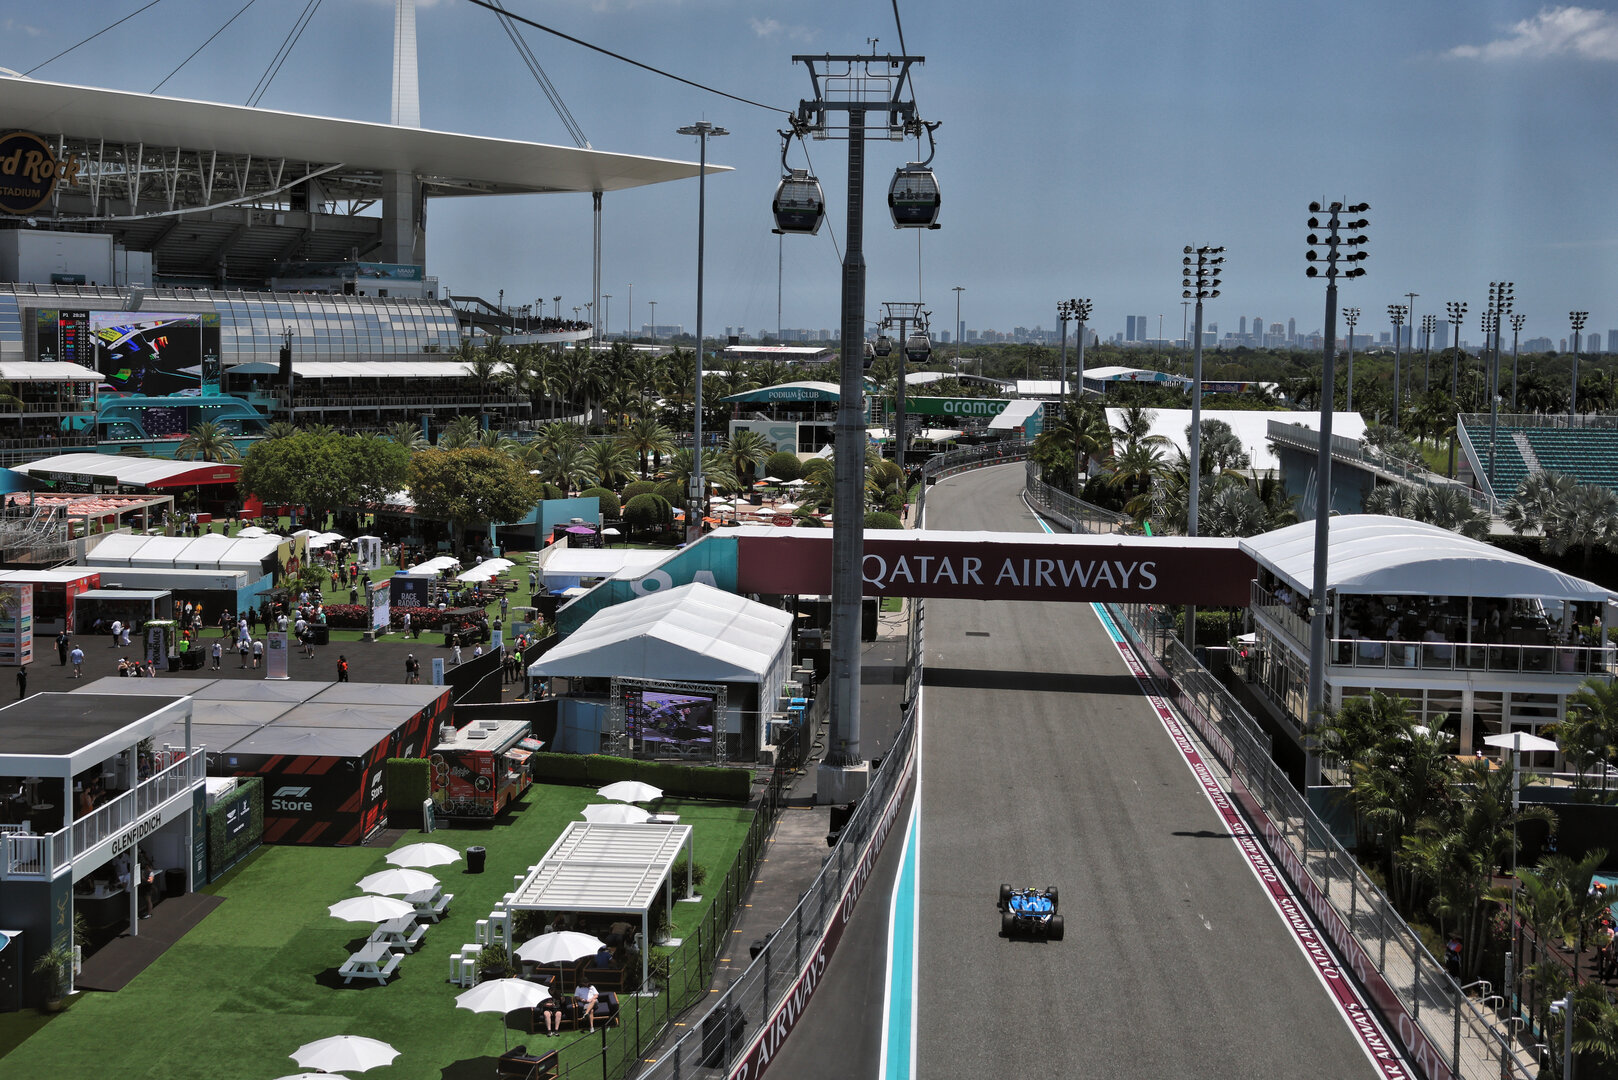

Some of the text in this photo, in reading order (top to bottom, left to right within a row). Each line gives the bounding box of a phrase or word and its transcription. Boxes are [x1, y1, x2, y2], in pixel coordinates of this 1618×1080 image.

[23, 150, 81, 187] Rock
[768, 391, 819, 399] PODIUM CLUB
[943, 400, 1007, 415] aramco
[862, 554, 1158, 590] QATAR AIRWAYS
[397, 599, 421, 607] RADIOS
[400, 592, 418, 600] RACE
[271, 799, 313, 811] Store
[272, 786, 312, 798] F1
[371, 784, 384, 801] Store
[1207, 786, 1230, 809] QATAR
[111, 812, 162, 855] GLENFIDDICH
[1250, 854, 1277, 882] QATAR
[842, 848, 873, 924] QATAR
[1266, 822, 1367, 984] QATAR AIRWAYS
[1280, 898, 1340, 979] QATAR AIRWAYS
[754, 942, 826, 1080] AIRWAYS
[1344, 1002, 1395, 1062] AIRWAYS
[1398, 1012, 1455, 1080] QAT
